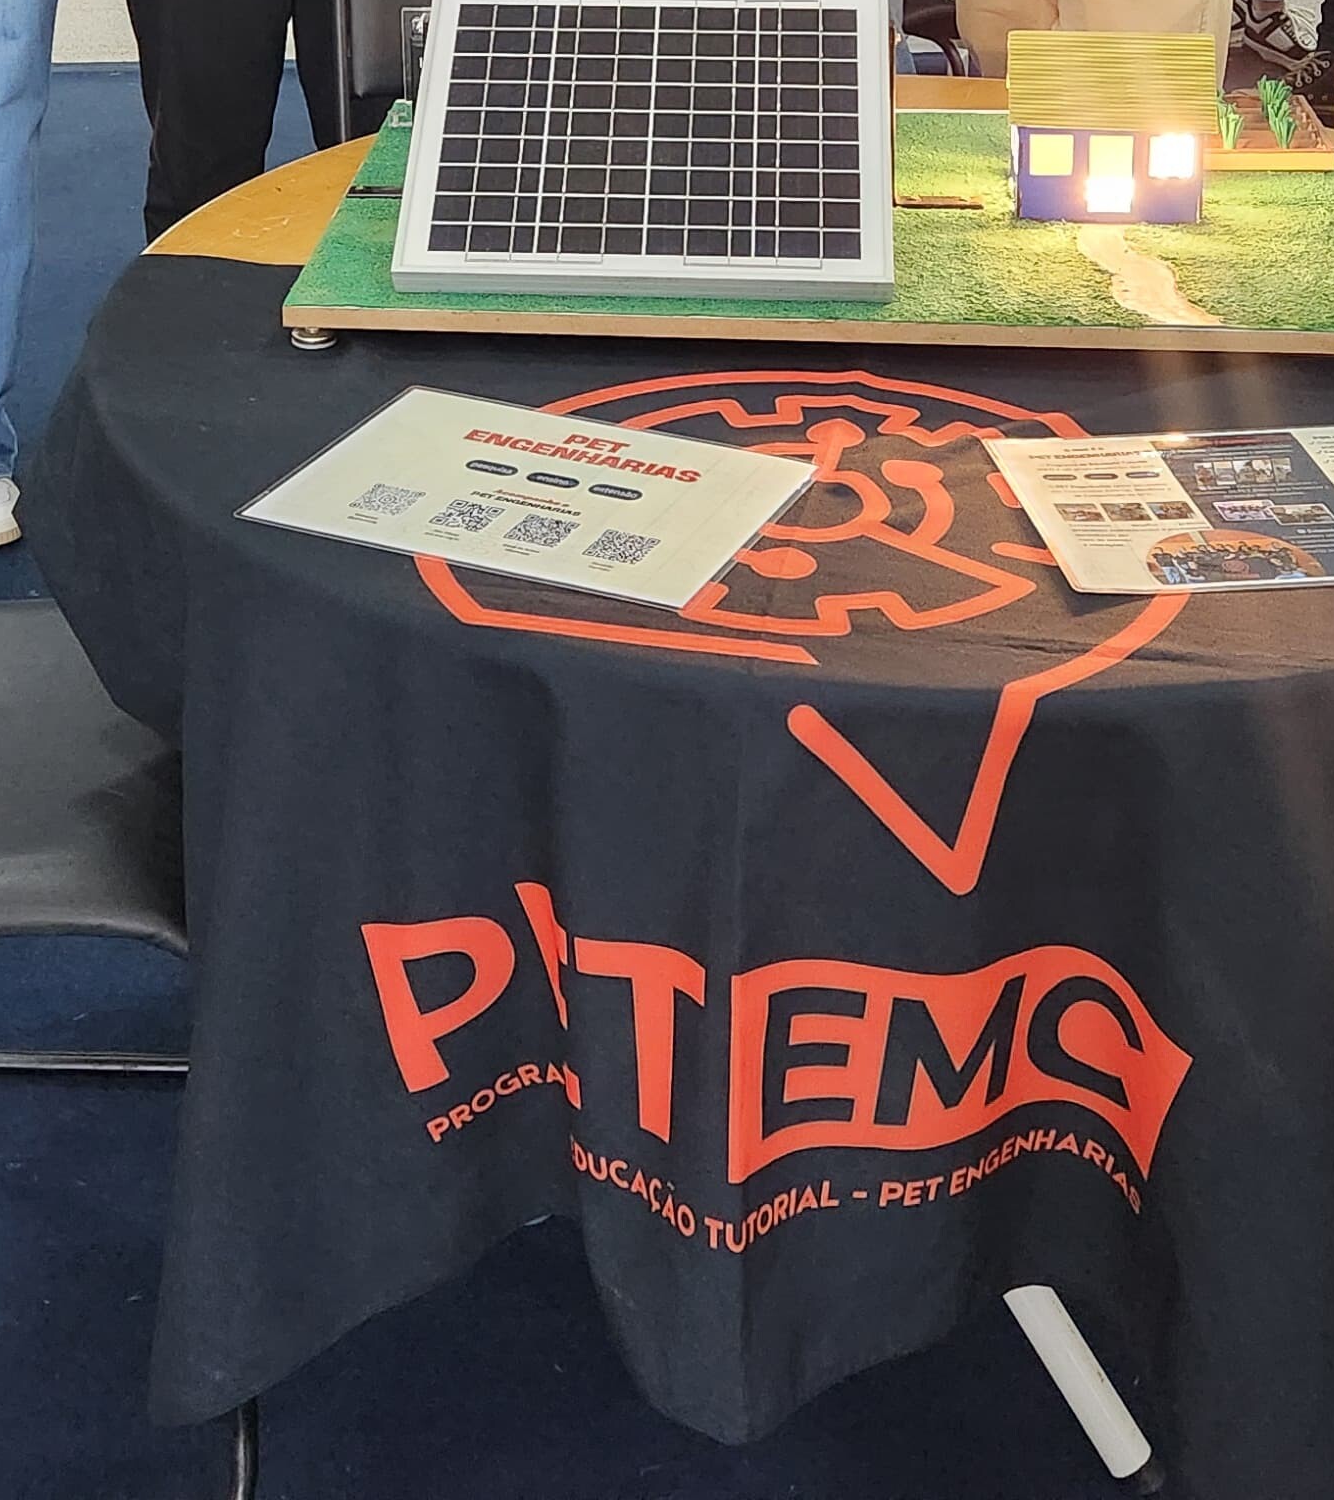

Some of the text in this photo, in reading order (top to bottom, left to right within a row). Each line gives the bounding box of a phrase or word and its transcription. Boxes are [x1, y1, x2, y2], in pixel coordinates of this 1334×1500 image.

[463, 428, 702, 484] ENGENHARIAS
[563, 433, 630, 453] PET
[704, 1179, 839, 1254] TUTORIAL
[878, 1176, 945, 1208] PET
[948, 1128, 1142, 1216] ENGENHARIAS
